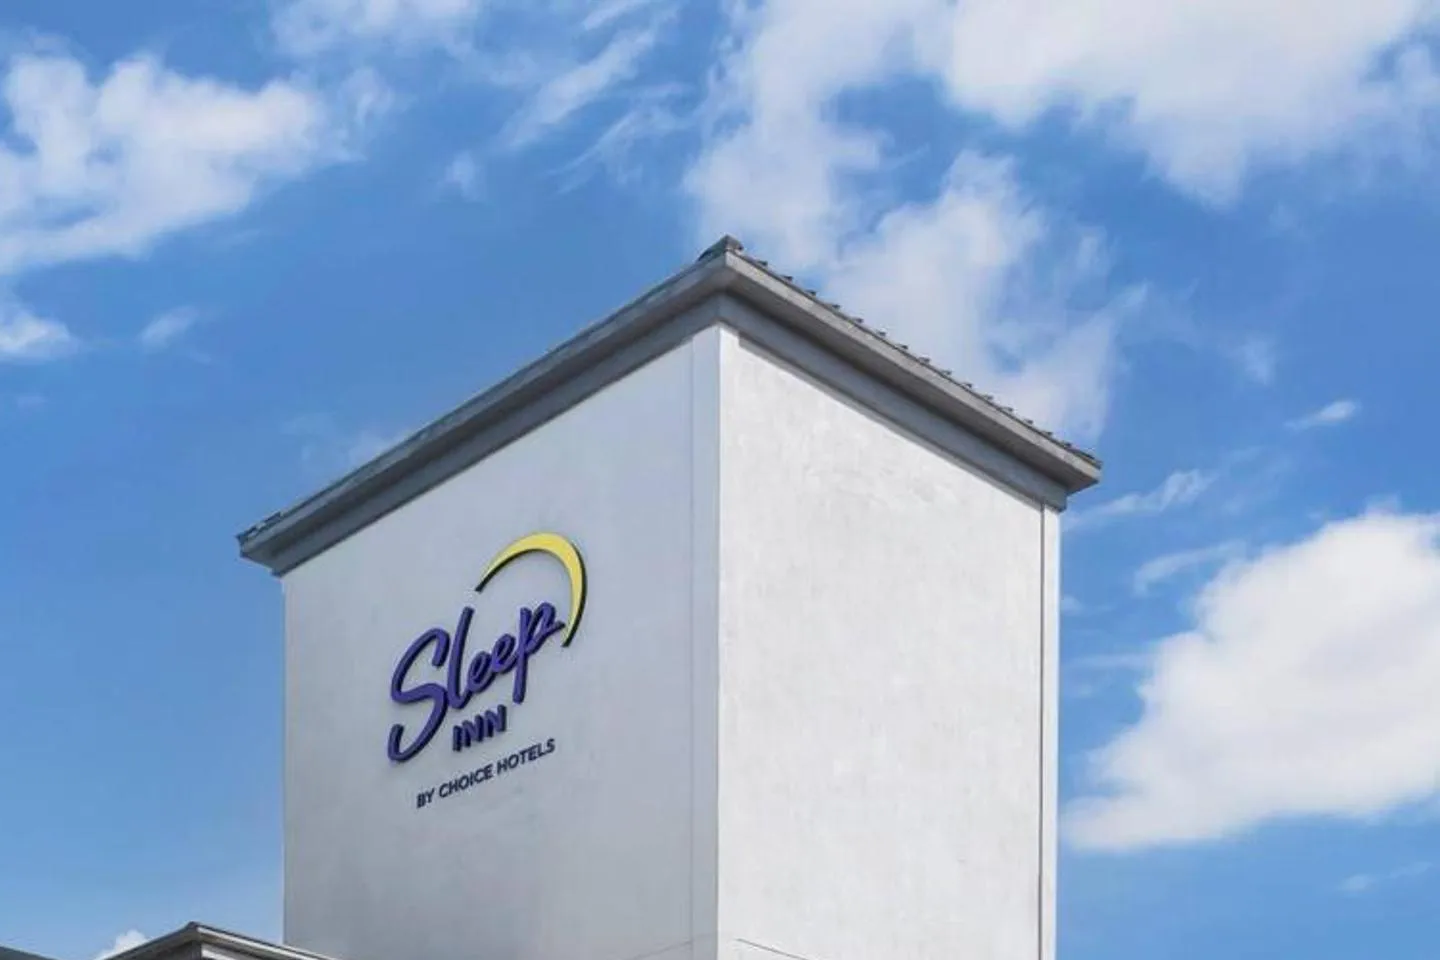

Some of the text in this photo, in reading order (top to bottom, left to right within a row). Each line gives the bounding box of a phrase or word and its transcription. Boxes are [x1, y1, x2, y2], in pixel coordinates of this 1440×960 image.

[387, 602, 564, 763] Sleep
[452, 704, 507, 752] INN
[416, 737, 556, 809] BY CHOICE HOTELS
